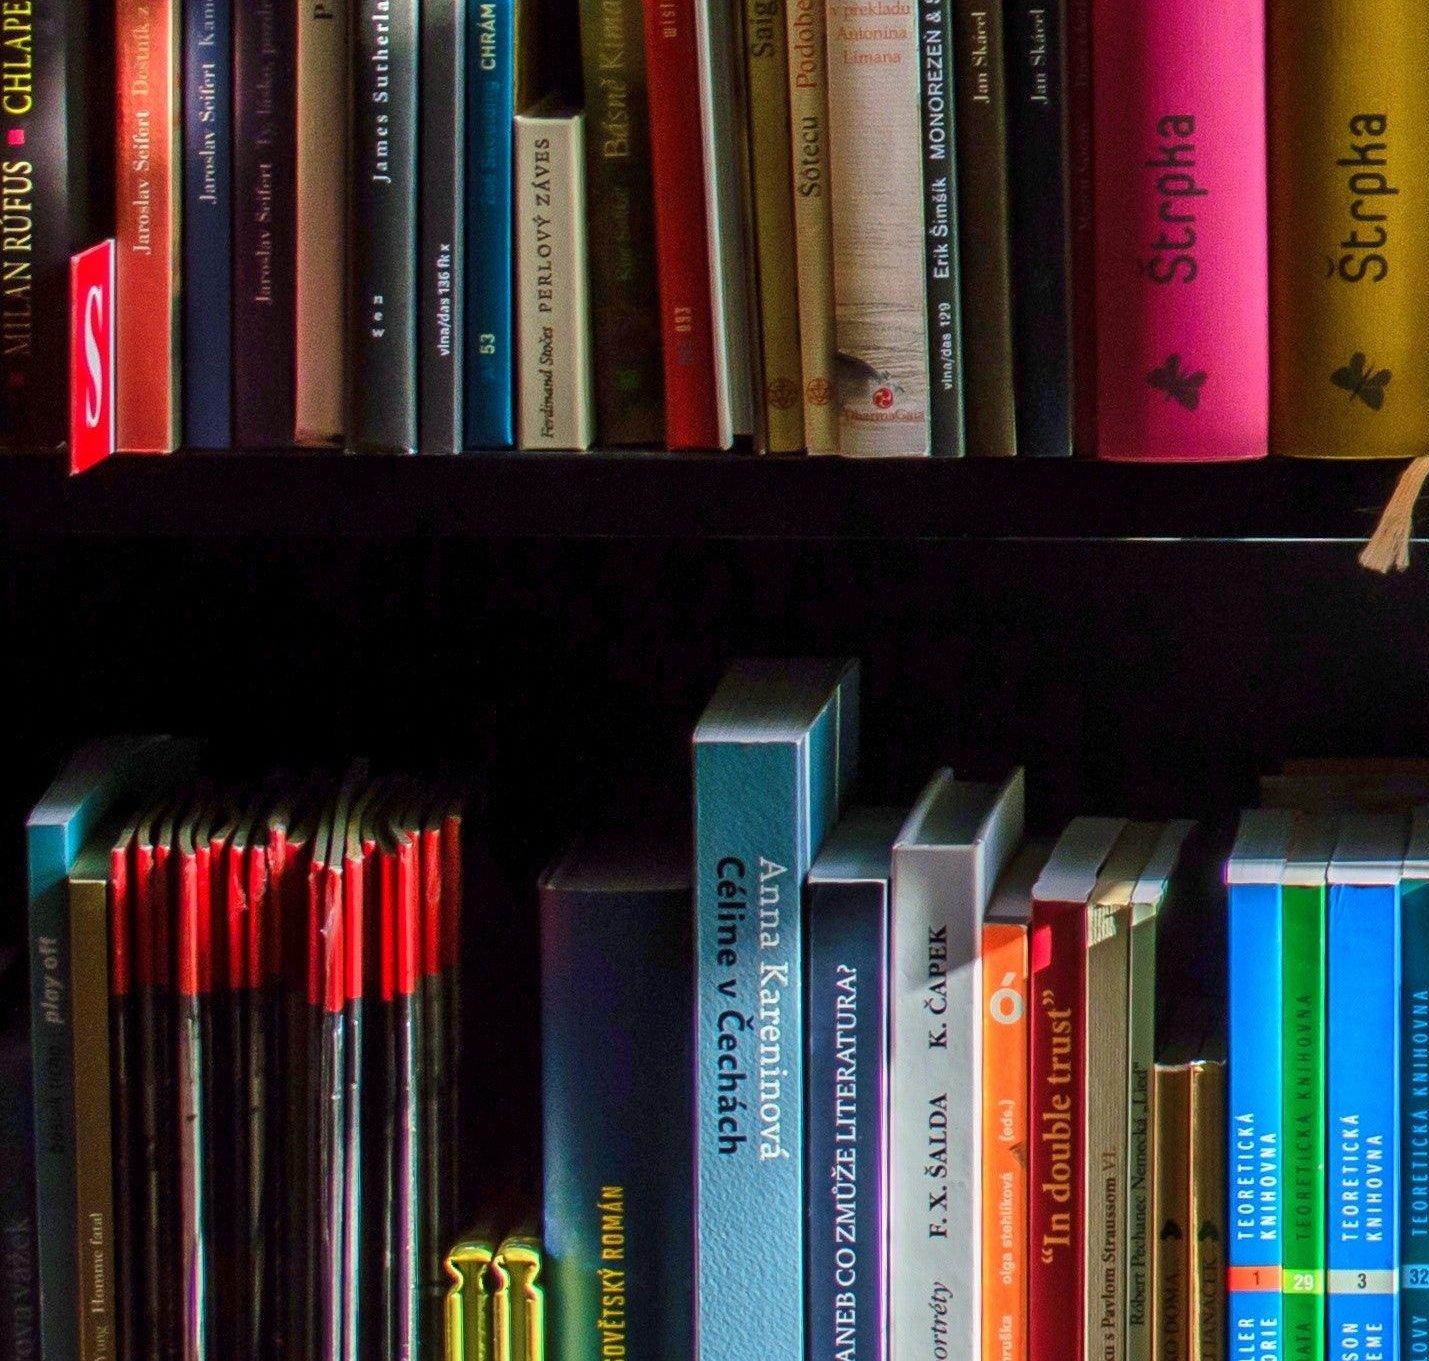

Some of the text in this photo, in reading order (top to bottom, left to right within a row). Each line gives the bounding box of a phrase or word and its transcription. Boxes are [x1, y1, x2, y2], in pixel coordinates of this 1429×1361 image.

[926, 10, 944, 24] &
[372, 114, 391, 183] James
[922, 29, 947, 160] MONOREZEŇ
[0, 161, 32, 251] RÚFUS
[533, 138, 552, 313] PERLOVÝ ZÁVES
[929, 177, 950, 237] Šimšík
[1136, 114, 1208, 283] Štrpka
[1326, 113, 1400, 283] Štrpka
[3, 256, 32, 356] MILAN
[934, 244, 951, 278] Erik
[717, 856, 754, 1155] Céline v Čechách
[759, 857, 790, 1160] Anna Kareninová
[923, 924, 947, 1239] F. X. ŠALDA K. ČAPEK
[1042, 1094, 1071, 1203] double
